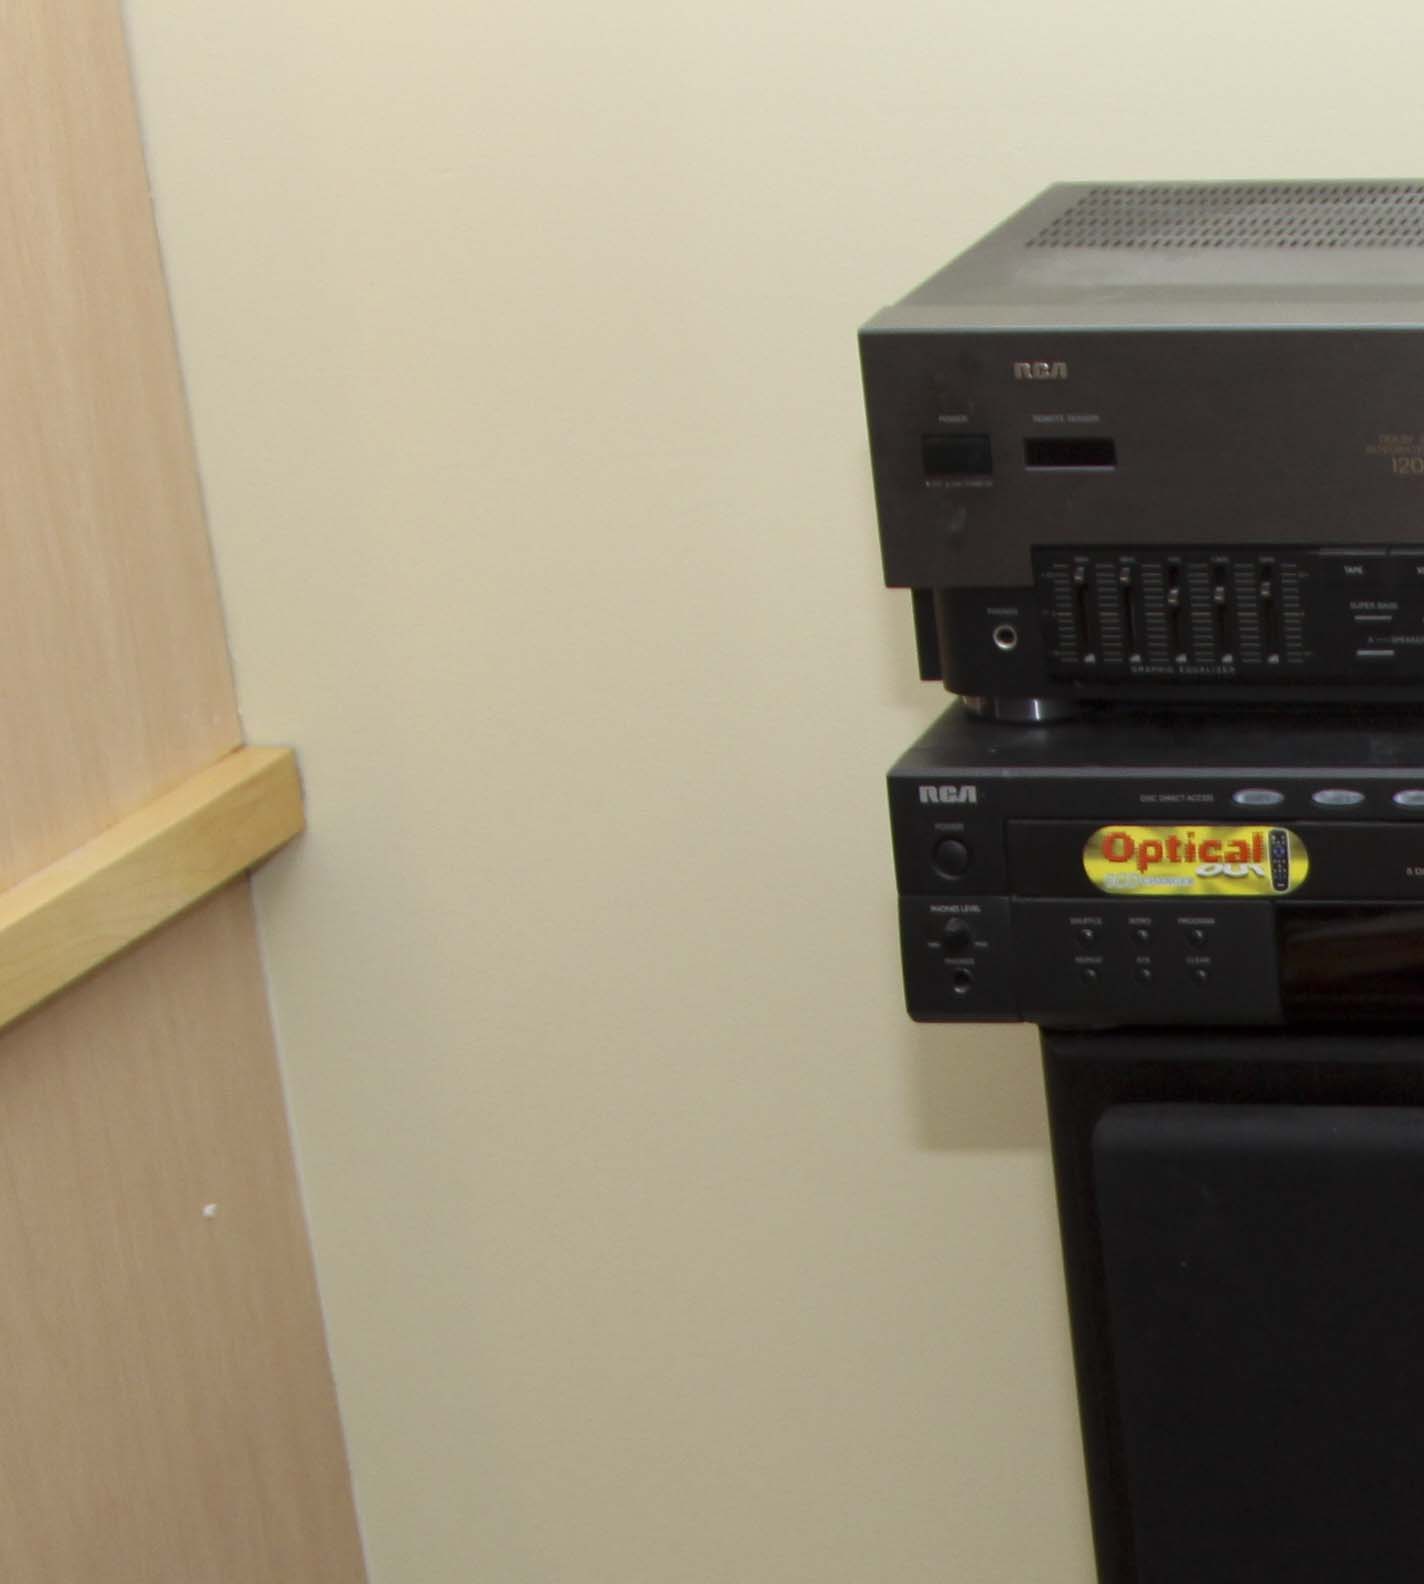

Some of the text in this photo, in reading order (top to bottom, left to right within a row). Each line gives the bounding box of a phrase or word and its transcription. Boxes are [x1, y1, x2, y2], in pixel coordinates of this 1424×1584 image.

[1014, 361, 1069, 381] RCA
[1392, 456, 1424, 474] 120
[1344, 565, 1364, 576] TAPE
[1350, 601, 1374, 611] SUPER
[1131, 664, 1236, 675] GRAPHIC EQUALIZER
[919, 784, 977, 804] RCA
[1102, 831, 1265, 874] Optical
[929, 903, 982, 914] PHONES LEVEL
